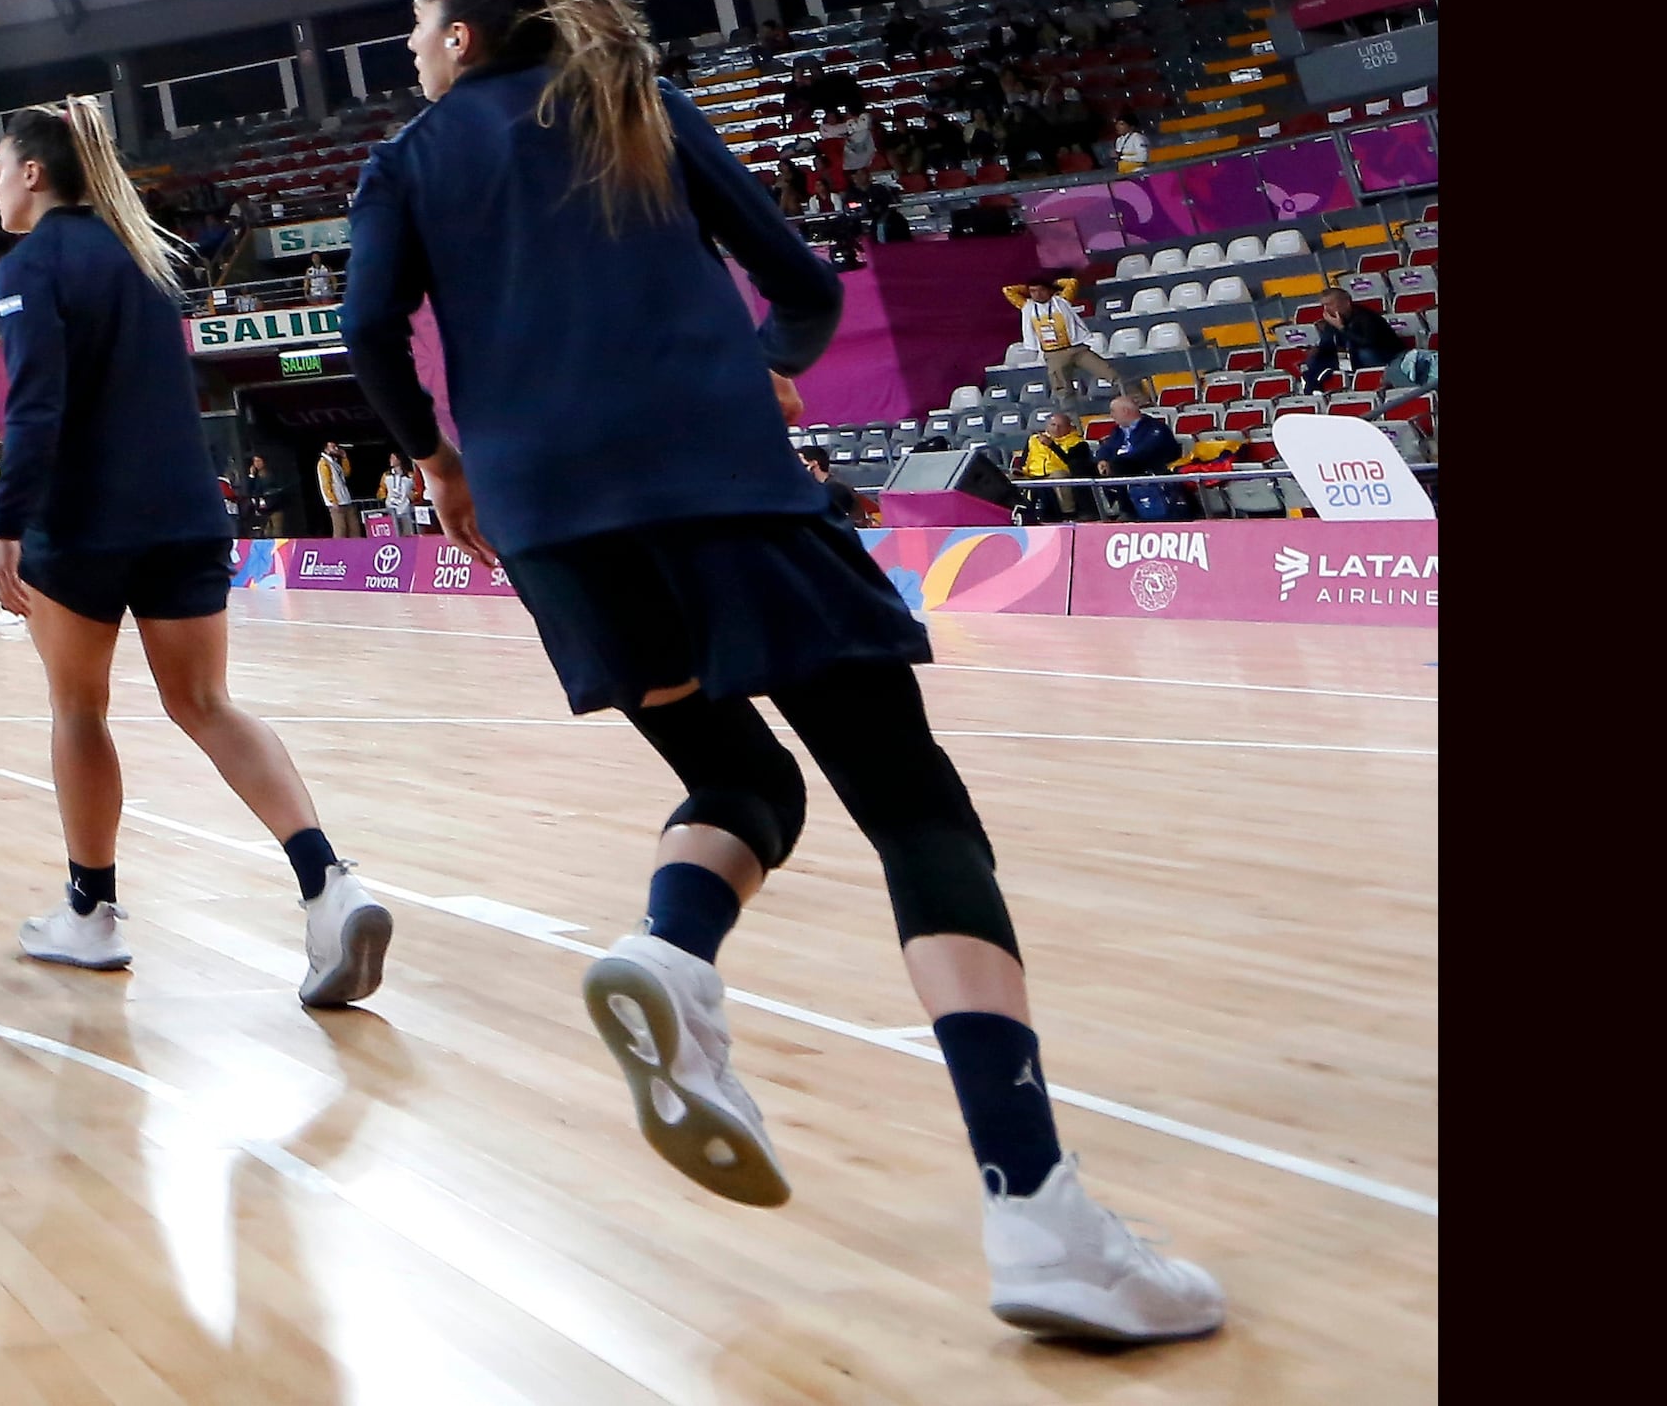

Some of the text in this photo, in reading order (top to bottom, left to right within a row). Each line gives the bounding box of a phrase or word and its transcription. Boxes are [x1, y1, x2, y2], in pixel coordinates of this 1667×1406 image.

[1362, 51, 1397, 70] 2019
[200, 310, 342, 345] SALID
[281, 356, 319, 373] SALIDA
[1325, 483, 1392, 507] 2019
[1106, 532, 1209, 571] GLORIA
[365, 576, 399, 589] TOYOTA
[433, 566, 470, 588] 2019
[1317, 588, 1438, 606] AIRLINE
